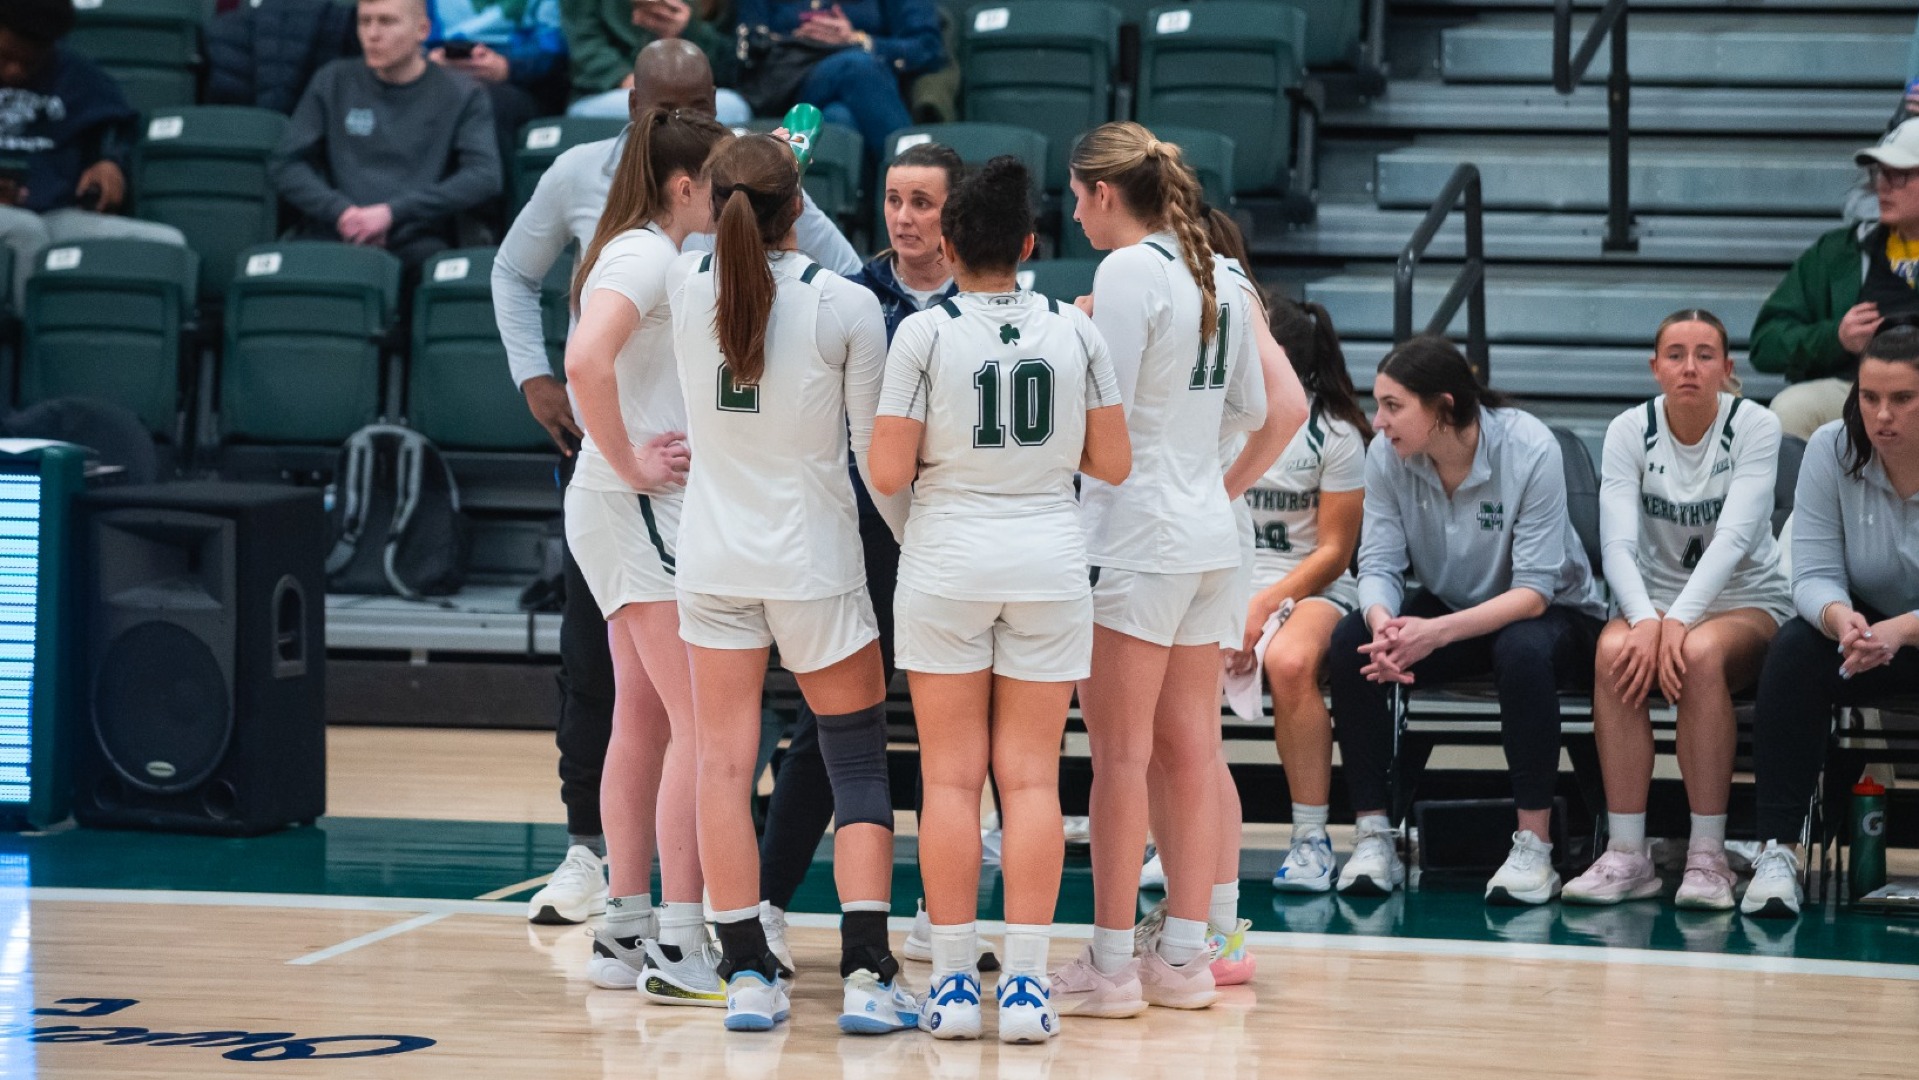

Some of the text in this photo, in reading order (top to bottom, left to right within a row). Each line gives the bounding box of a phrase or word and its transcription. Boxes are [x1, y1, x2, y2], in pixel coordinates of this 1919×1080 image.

[1189, 303, 1230, 390] 11
[973, 358, 1054, 448] 10
[1641, 492, 1727, 526] MERCYHUR
[1680, 535, 1705, 568] 4
[1862, 811, 1884, 836] G
